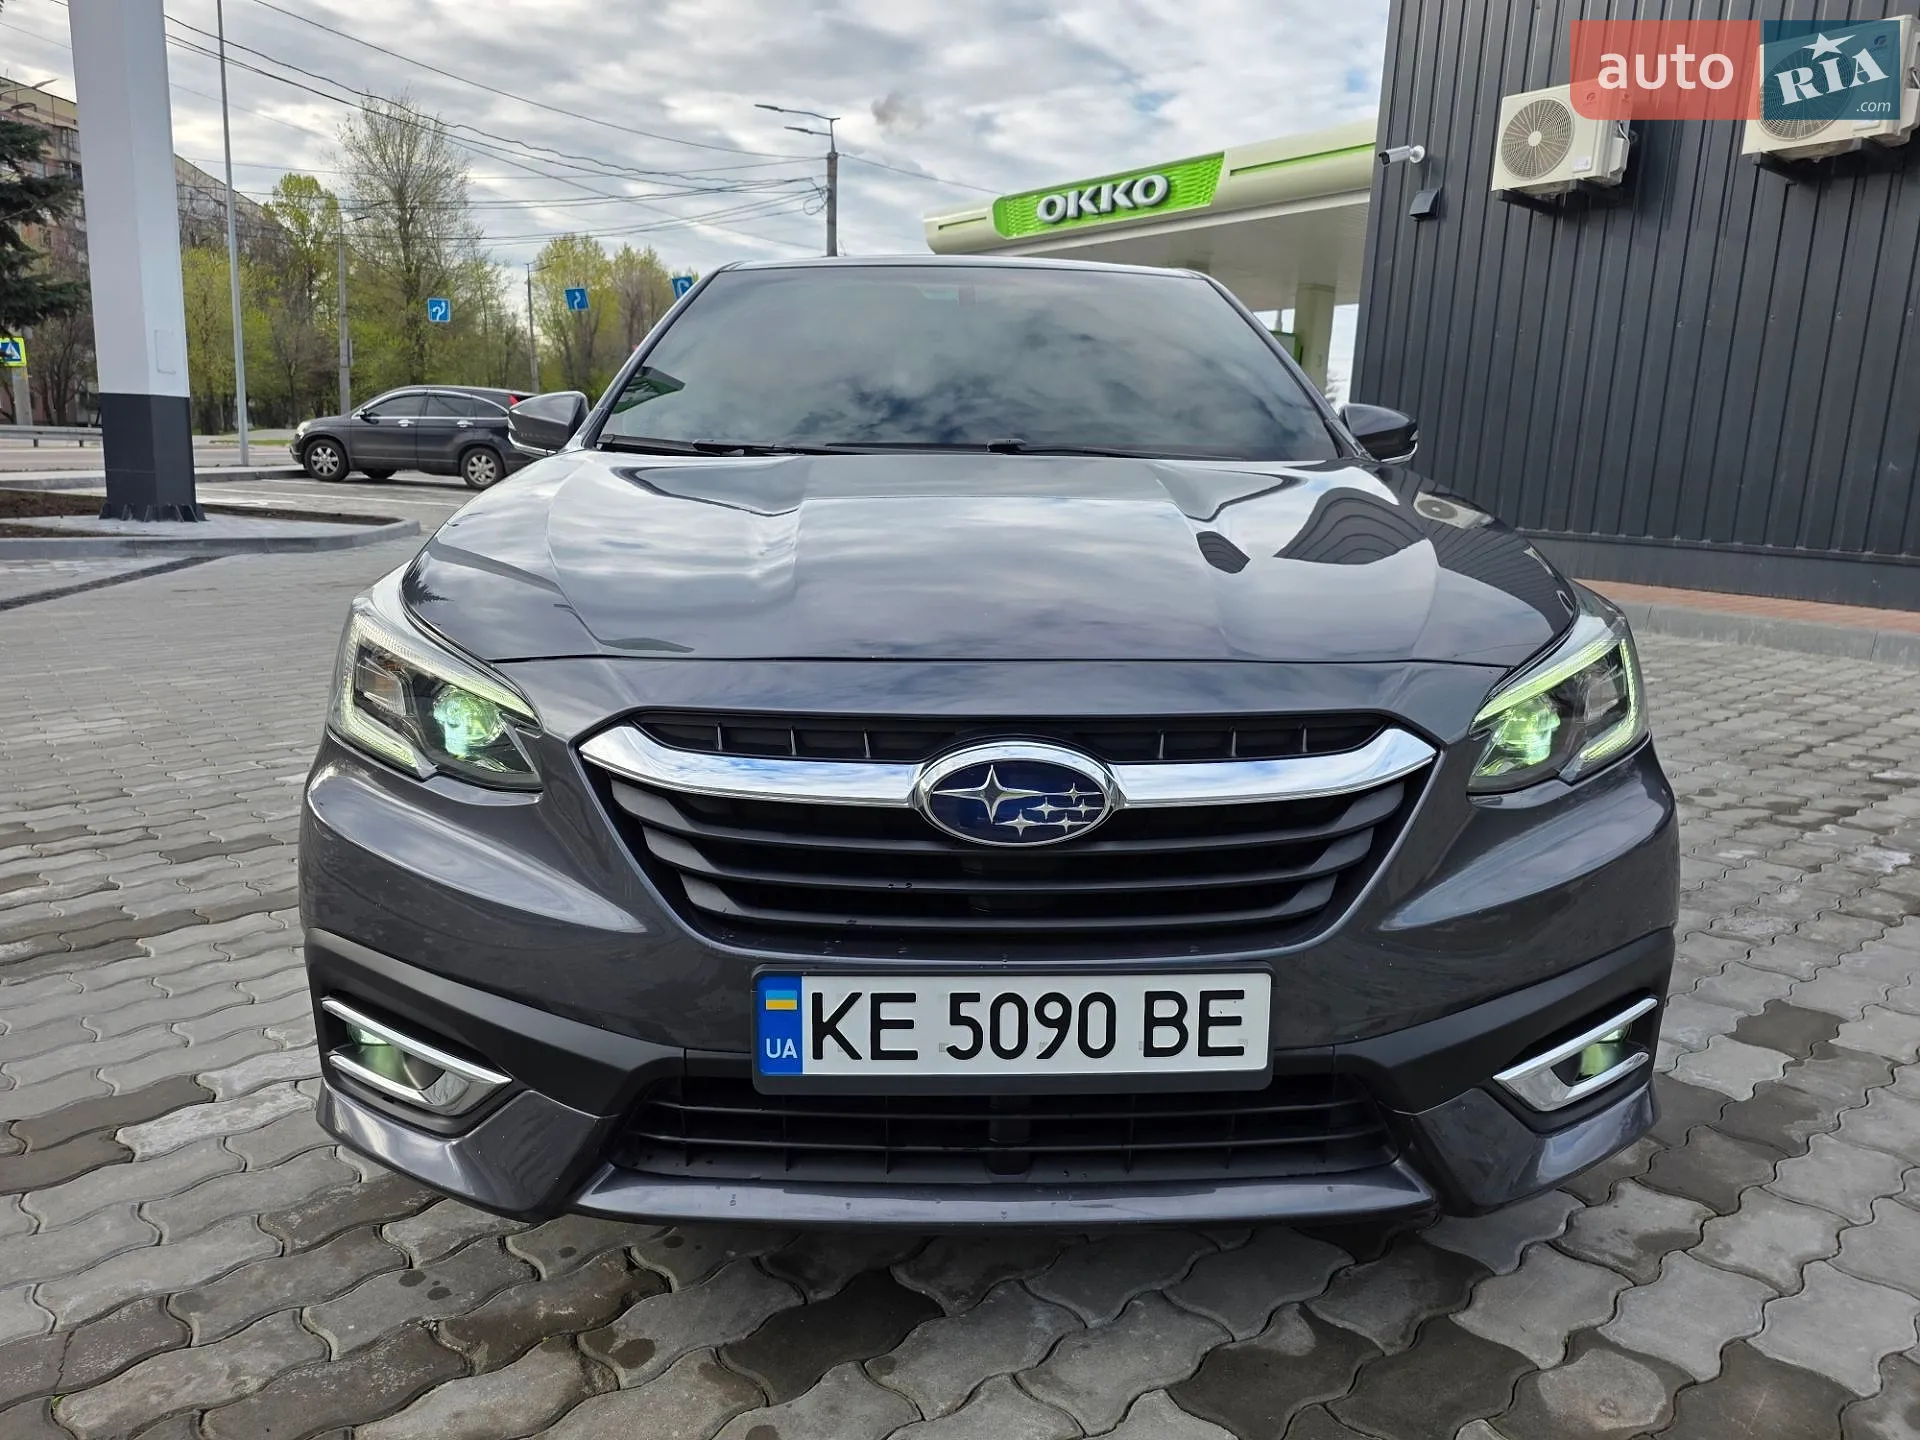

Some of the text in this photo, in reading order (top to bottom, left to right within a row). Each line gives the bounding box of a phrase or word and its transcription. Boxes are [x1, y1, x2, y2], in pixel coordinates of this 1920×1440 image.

[1036, 174, 1169, 224] OKKO
[765, 1038, 798, 1060] UA
[811, 989, 1246, 1061] KE 5090 BE
